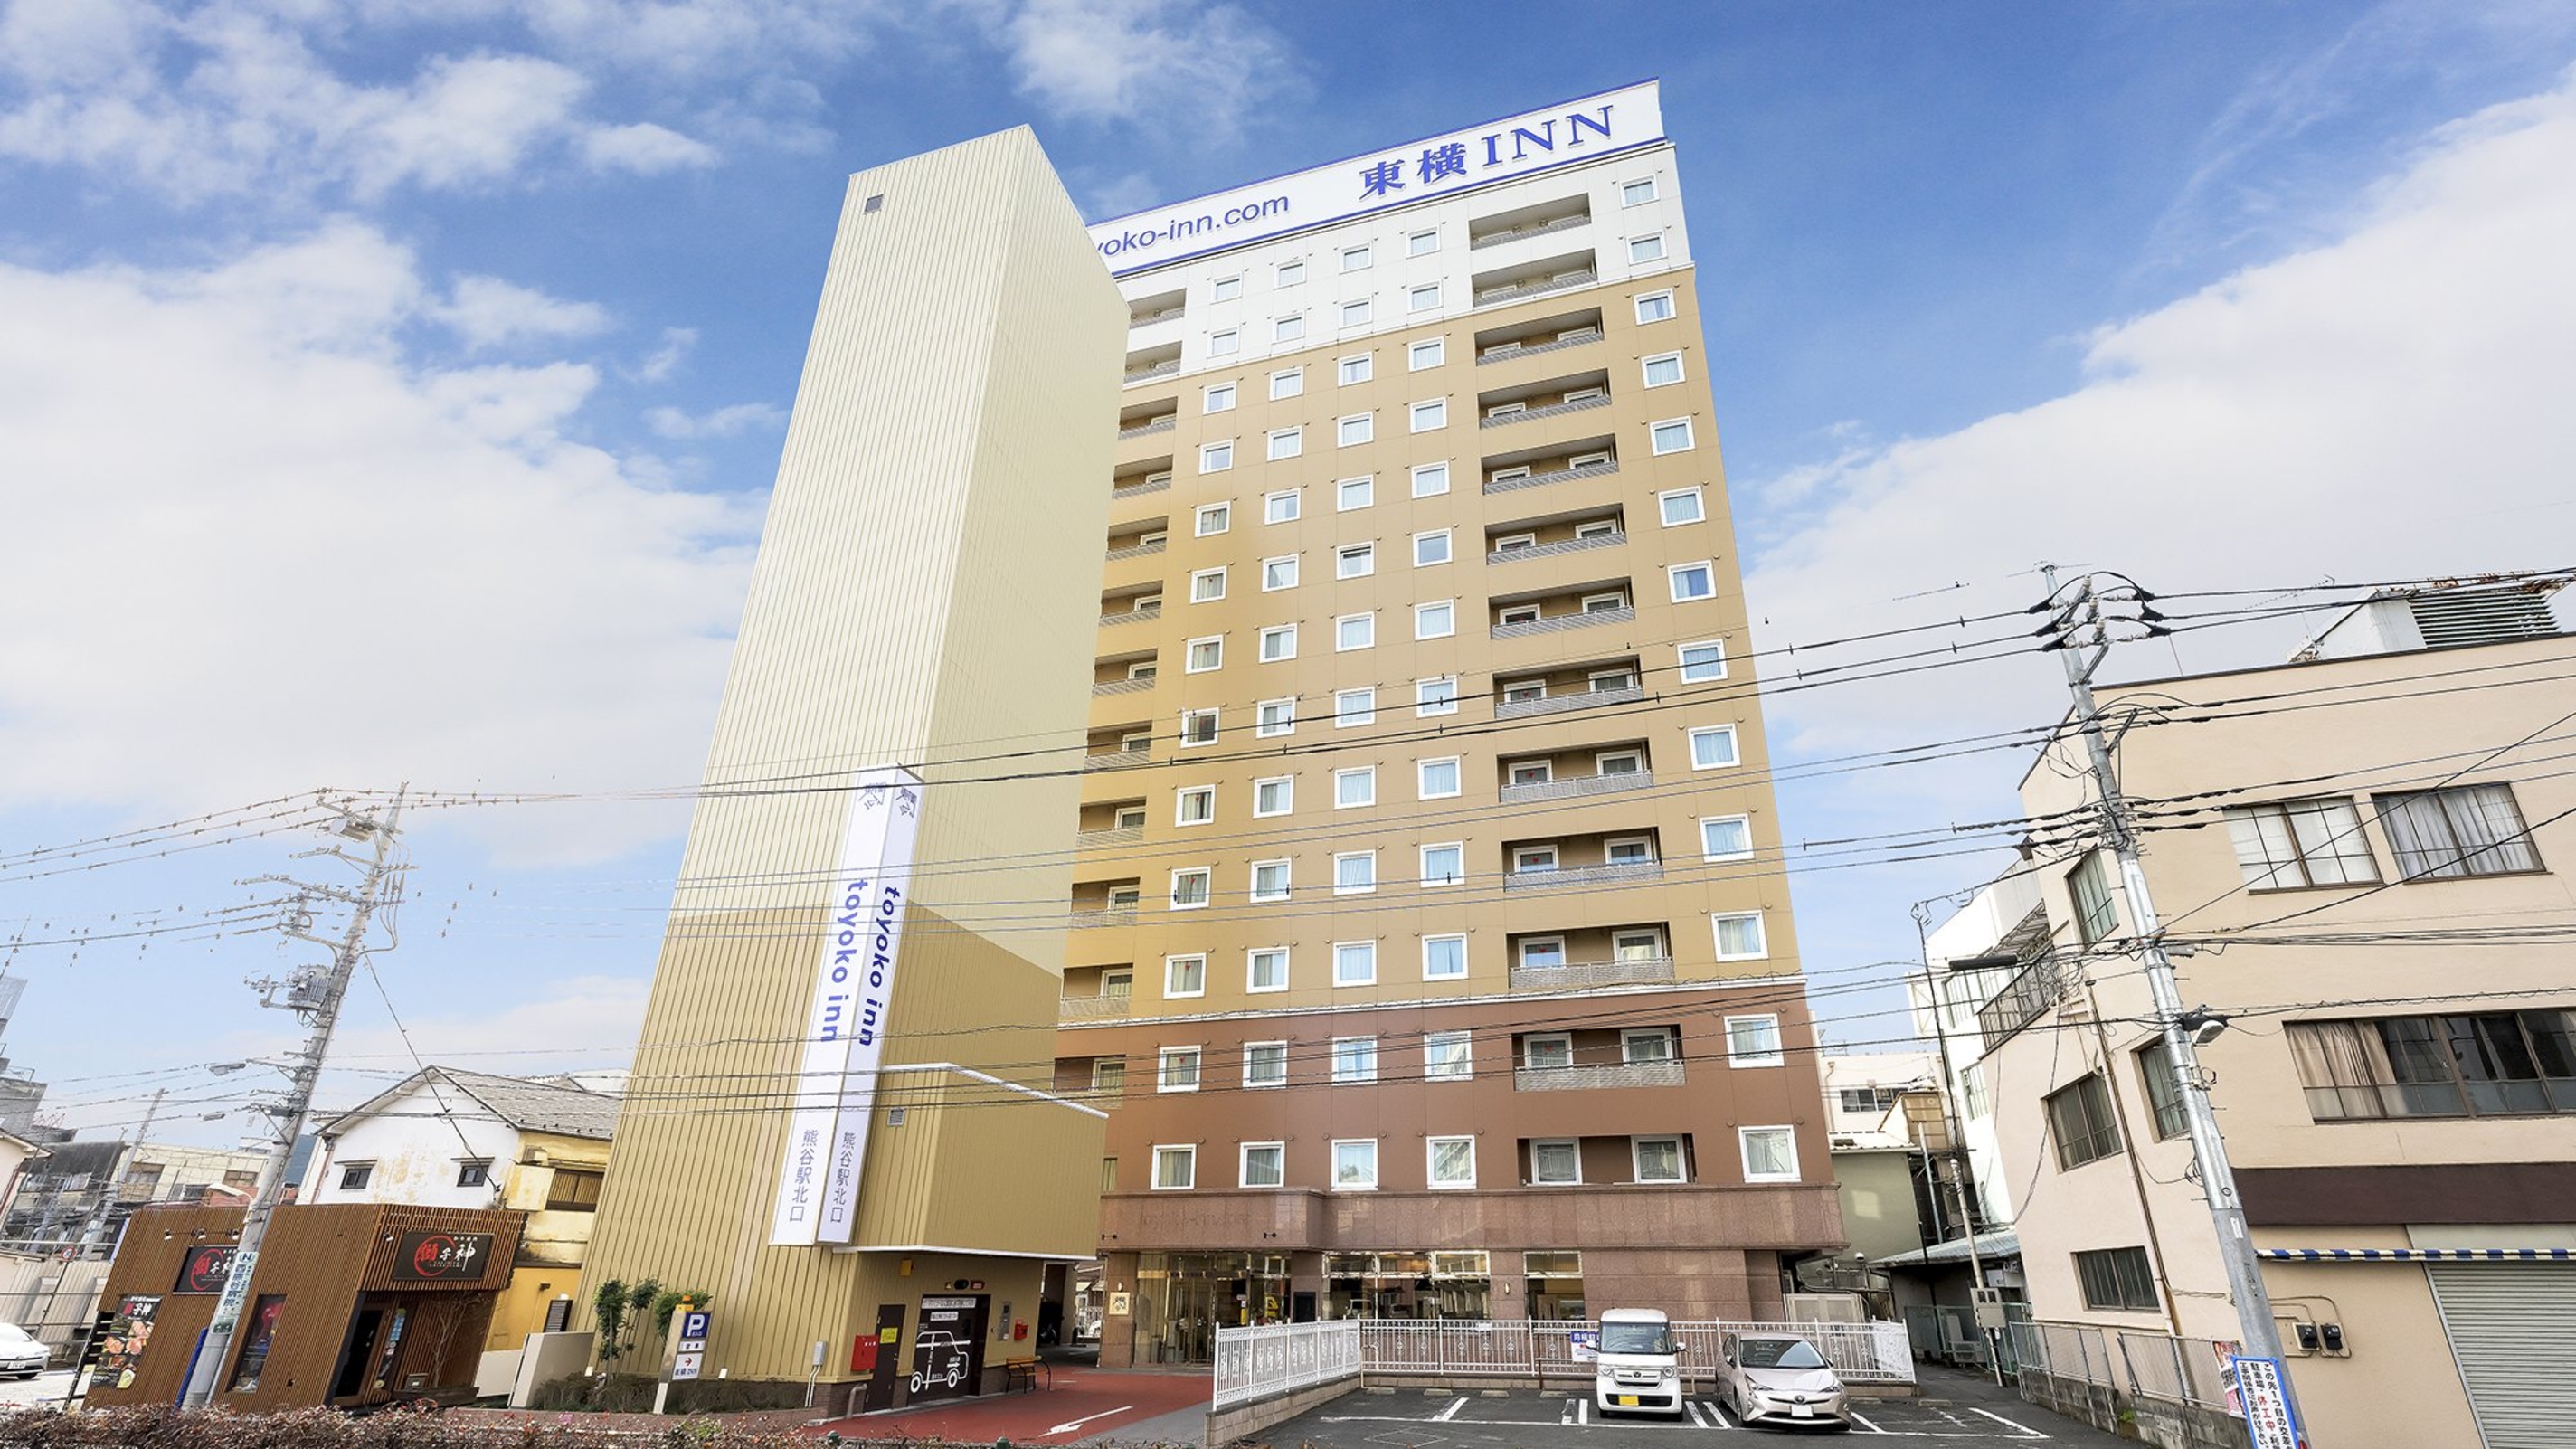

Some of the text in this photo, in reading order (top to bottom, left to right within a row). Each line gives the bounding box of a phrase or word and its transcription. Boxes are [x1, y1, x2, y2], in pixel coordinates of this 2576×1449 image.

[820, 879, 868, 1042] toyoko inn
[859, 886, 901, 1046] toyoko inn
[789, 1130, 819, 1223] 熊谷駅北口
[829, 1131, 857, 1223] 熊谷駅北口
[687, 1314, 705, 1337] P
